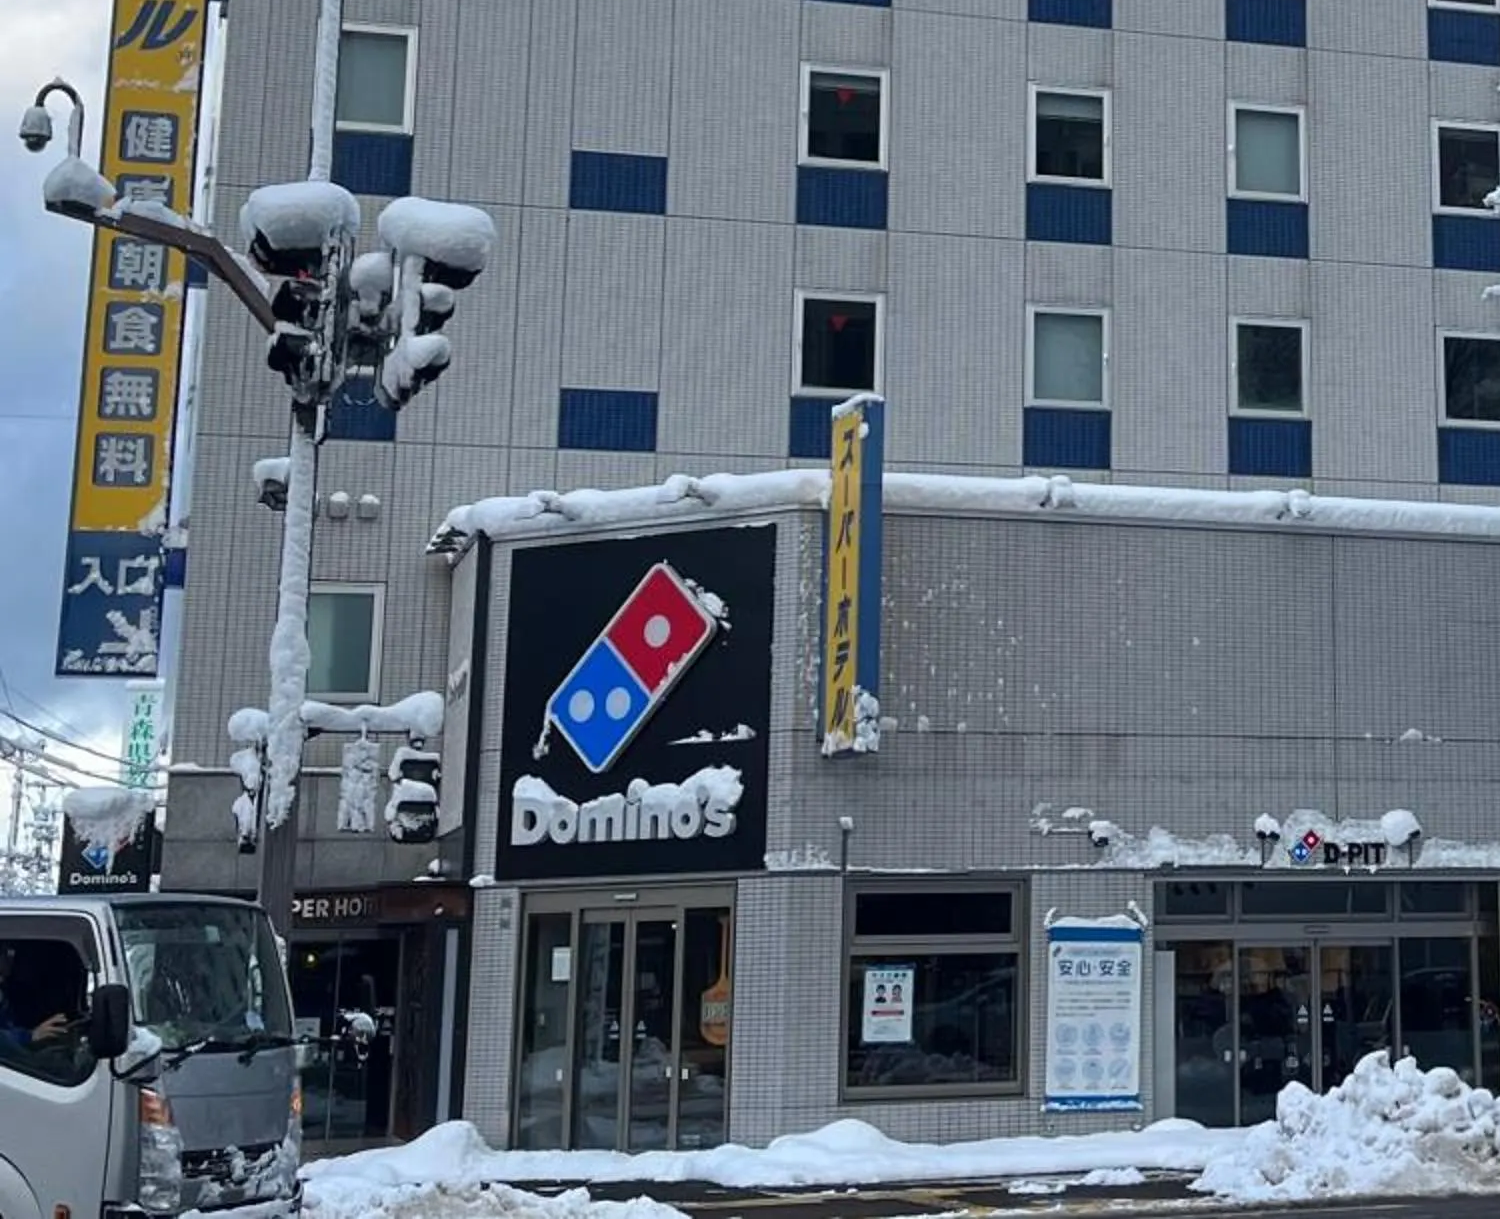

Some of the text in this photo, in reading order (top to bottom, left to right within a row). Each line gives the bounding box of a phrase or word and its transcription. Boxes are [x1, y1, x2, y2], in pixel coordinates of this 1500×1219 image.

[67, 555, 159, 596] 入口
[831, 426, 856, 729] スーパーホテル
[511, 781, 738, 845] Domino's
[1323, 841, 1386, 865] D-PIT
[69, 871, 138, 886] Domino's
[291, 898, 330, 918] PER
